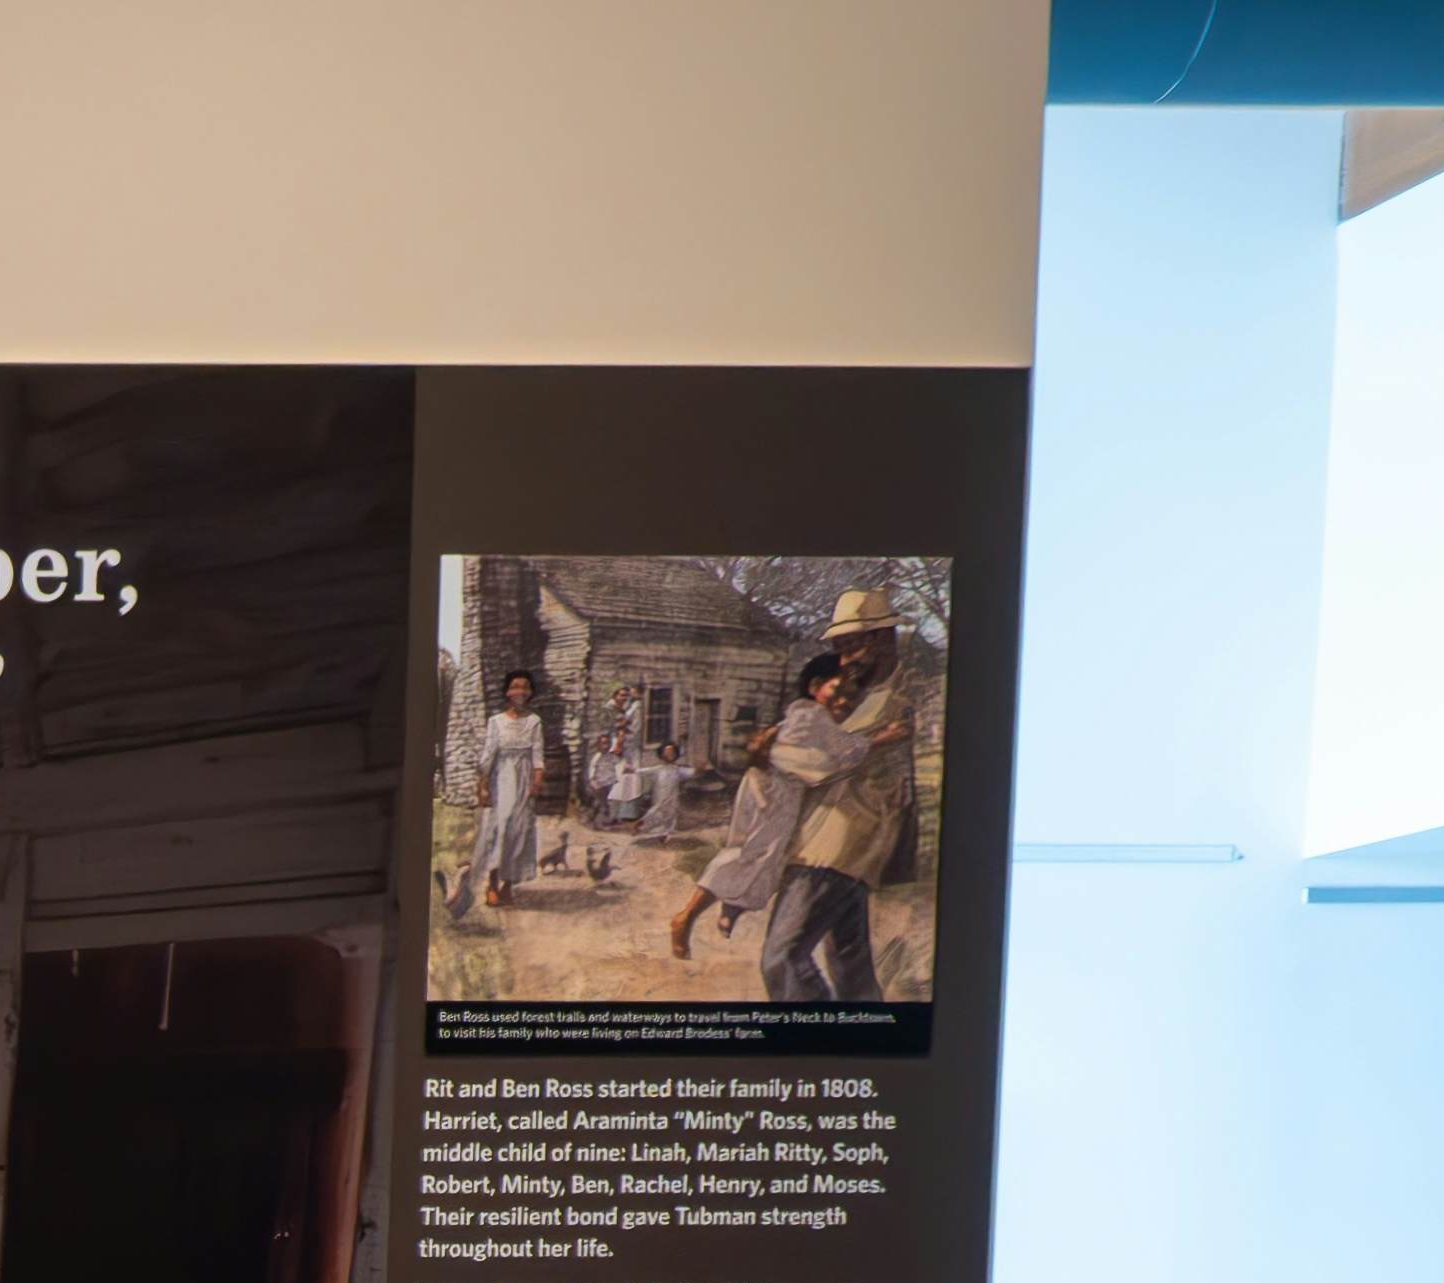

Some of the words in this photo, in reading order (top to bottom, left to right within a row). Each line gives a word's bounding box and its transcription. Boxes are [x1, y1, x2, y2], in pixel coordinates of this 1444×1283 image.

[425, 1078, 454, 1098] Rit
[458, 1077, 497, 1098] and
[501, 1078, 540, 1099] Ben
[545, 1078, 594, 1098] Ross
[597, 1077, 672, 1098] started
[676, 1077, 726, 1098] their
[729, 1078, 793, 1101] family
[797, 1079, 816, 1098] in
[821, 1078, 878, 1098] 1808.
[421, 1174, 496, 1197] Robert,
[501, 1174, 566, 1199] Minty,
[571, 1174, 615, 1197] Ben,
[620, 1174, 694, 1197] Rachel,
[699, 1173, 766, 1198] Henry,
[769, 1173, 809, 1194] and
[813, 1174, 886, 1194] Moses.
